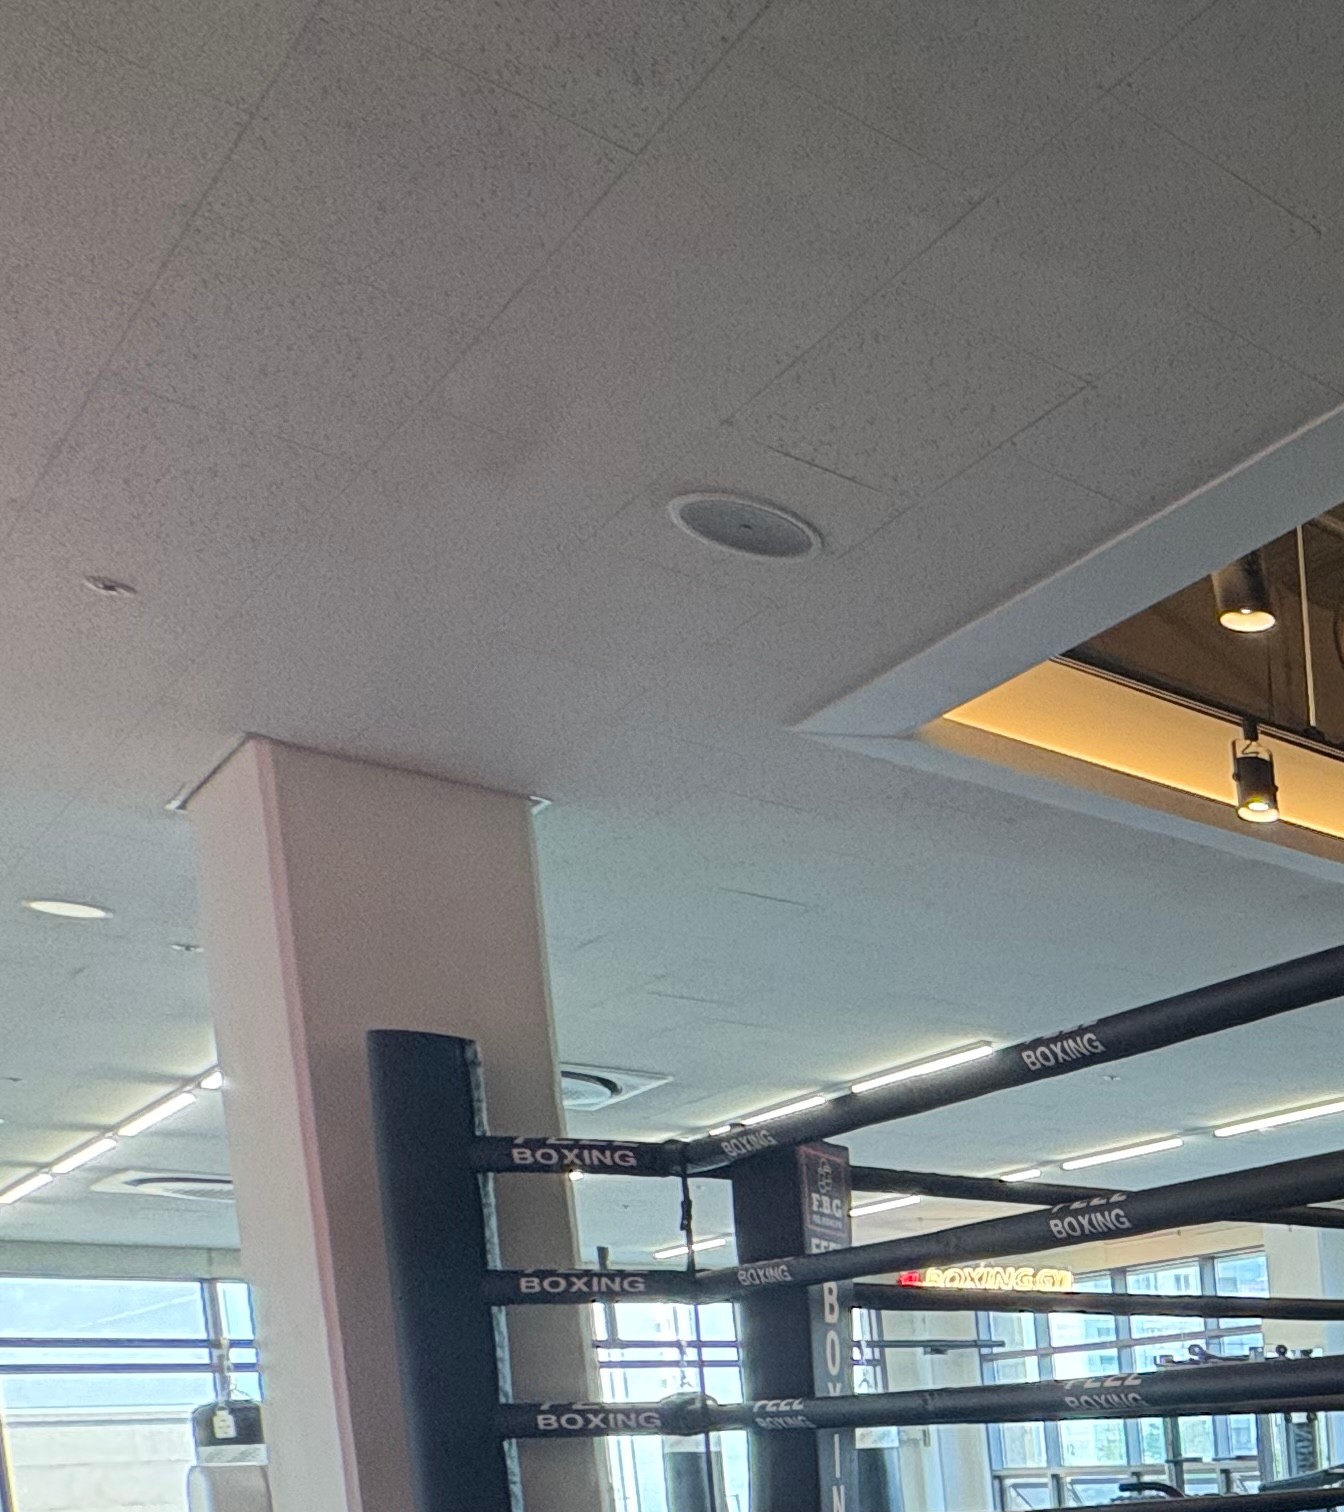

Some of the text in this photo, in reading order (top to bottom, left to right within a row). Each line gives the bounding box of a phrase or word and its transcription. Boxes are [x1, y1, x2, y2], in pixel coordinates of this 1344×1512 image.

[1021, 1032, 1107, 1071] BOXING
[720, 1129, 778, 1157] BOXING
[511, 1149, 638, 1167] BOXING
[1050, 1208, 1133, 1239] BOXING
[519, 1276, 647, 1294] BOXING
[736, 1265, 794, 1286] BOXING
[536, 1411, 662, 1430] BOXING
